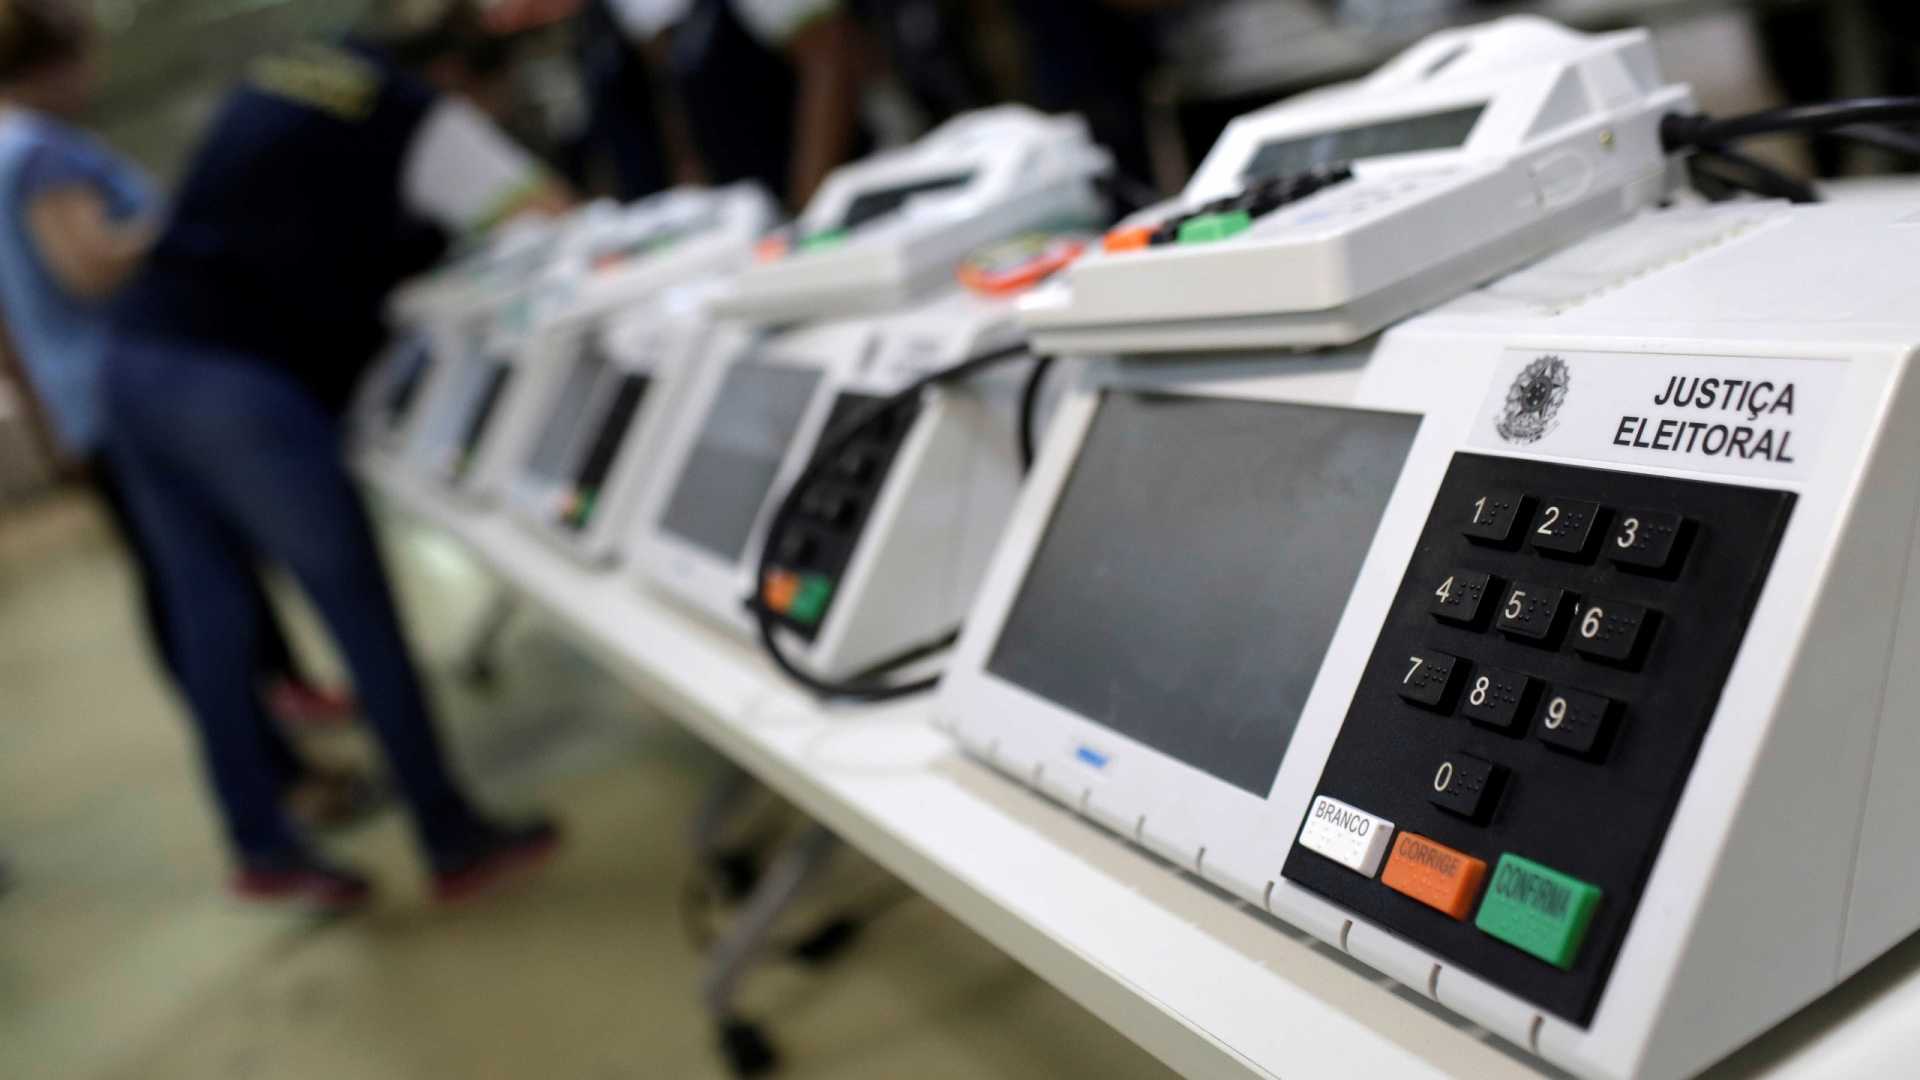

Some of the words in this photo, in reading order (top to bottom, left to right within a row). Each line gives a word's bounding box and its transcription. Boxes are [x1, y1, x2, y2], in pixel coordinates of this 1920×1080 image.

[1654, 375, 1795, 421] JUSTIÇA
[1612, 416, 1795, 463] ELEITORAL
[1472, 496, 1487, 523] 1
[1537, 506, 1559, 535] 2
[1617, 518, 1639, 548] 3
[1435, 576, 1454, 603] 4
[1504, 591, 1525, 619] 5
[1580, 607, 1603, 638] 6
[1402, 656, 1423, 684] 7
[1470, 676, 1490, 706] 8
[1544, 697, 1567, 729] 9
[1434, 762, 1453, 791] 0
[1315, 800, 1370, 837] BRANCO
[1400, 836, 1459, 878] CORRIGE
